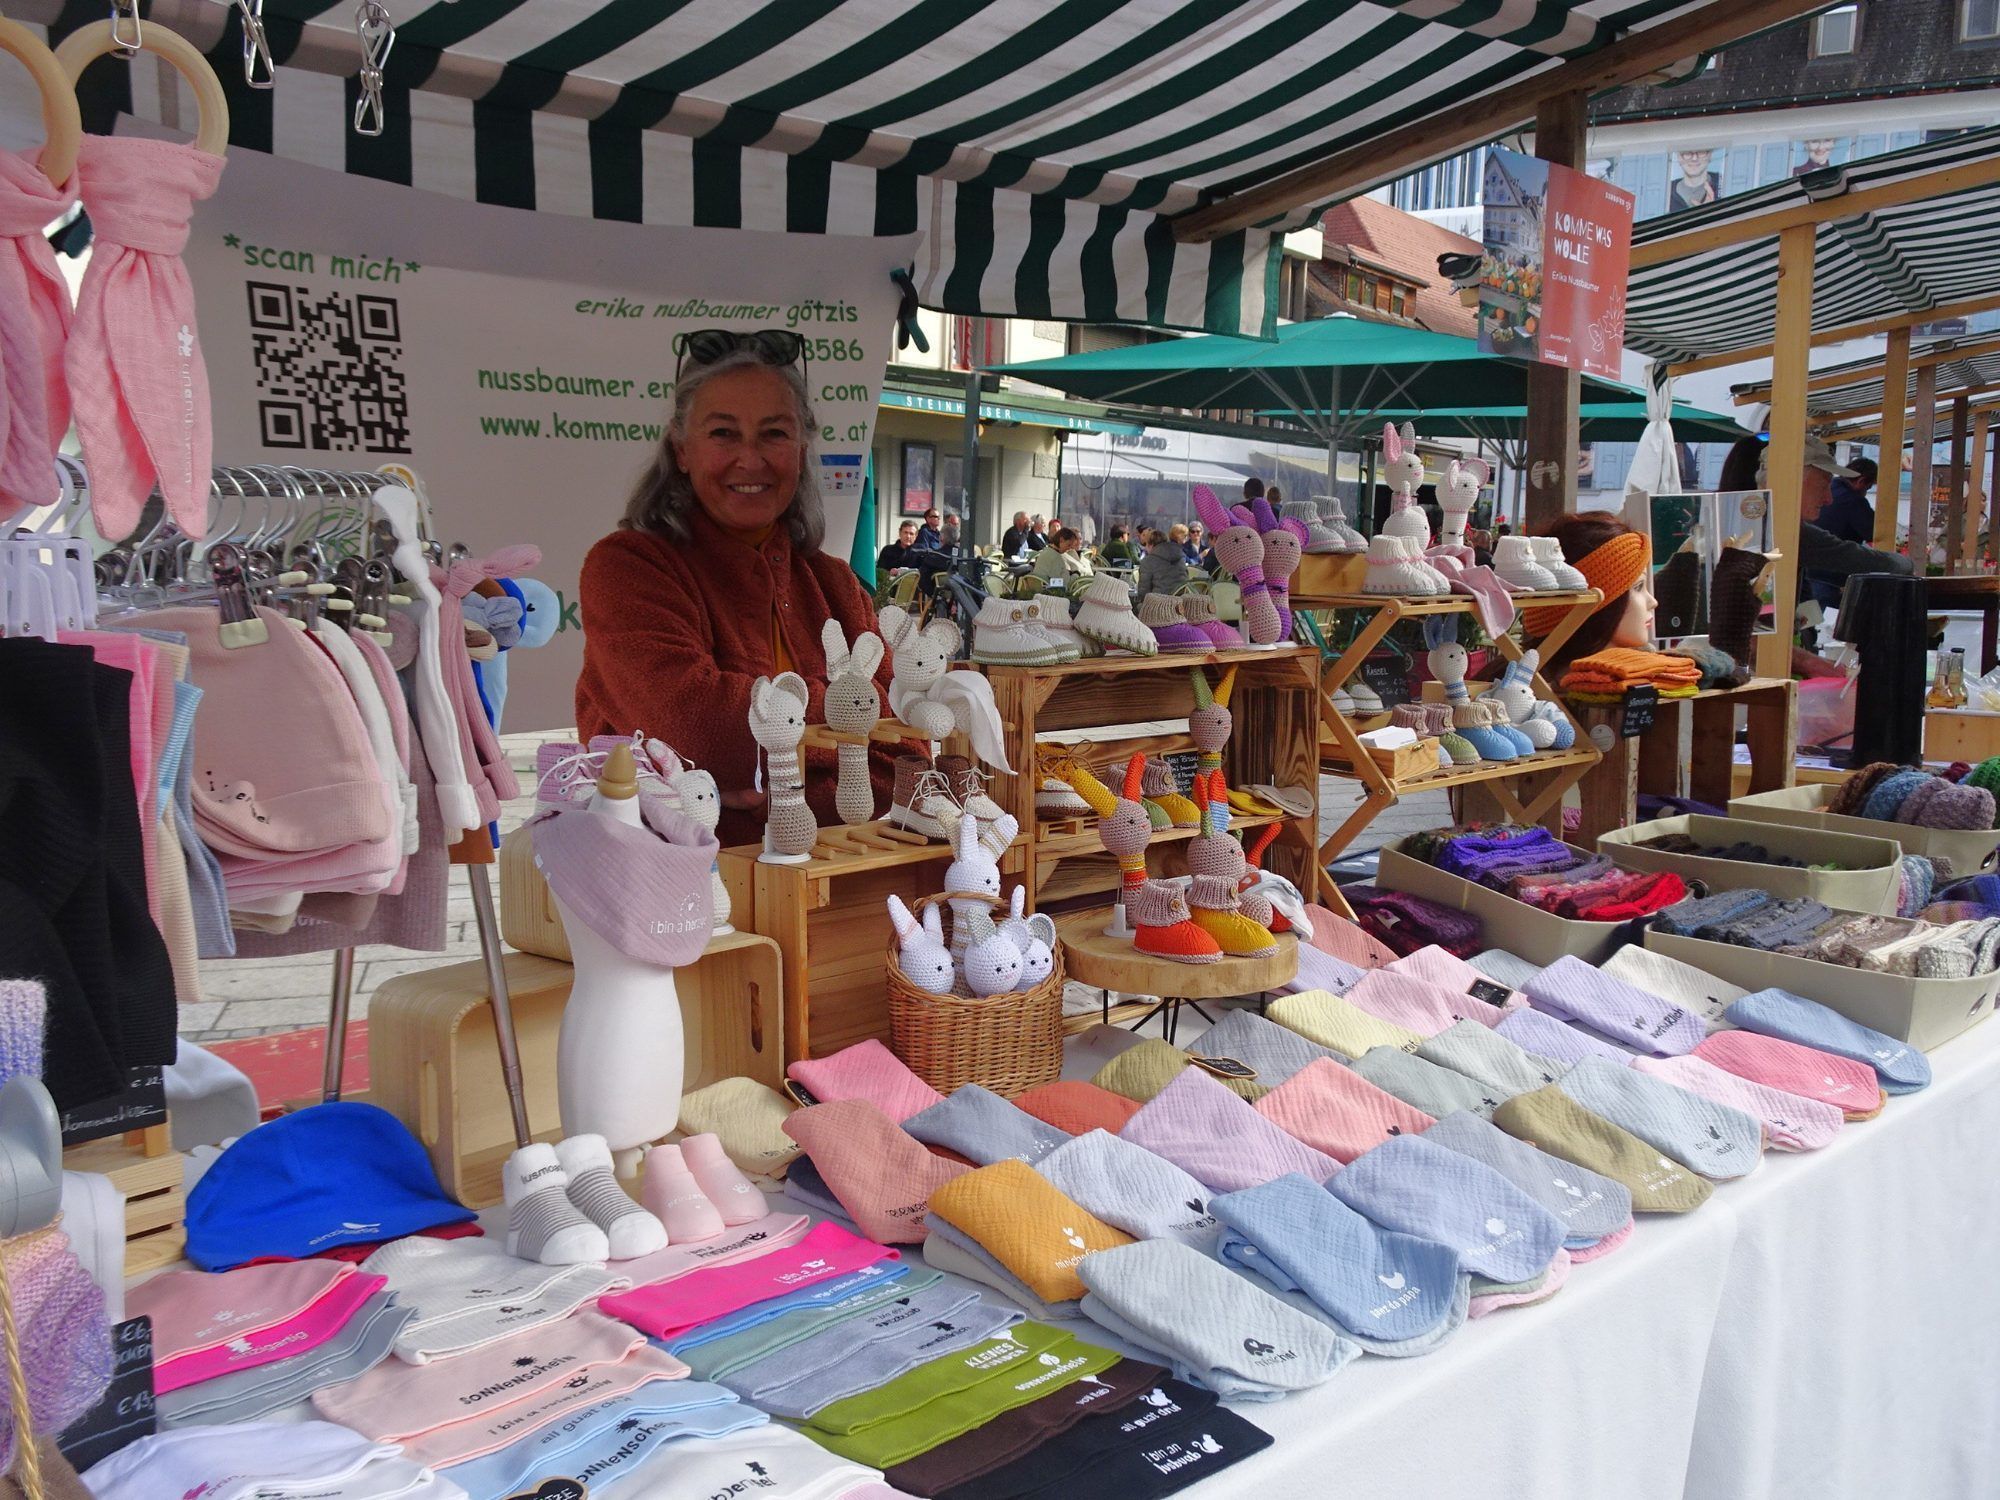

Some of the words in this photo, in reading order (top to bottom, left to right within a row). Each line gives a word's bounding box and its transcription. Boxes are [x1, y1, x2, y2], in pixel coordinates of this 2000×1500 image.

[1555, 211, 1594, 240] KOMME
[1596, 225, 1613, 248] WAS
[1553, 236, 1590, 265] WOLLE
[575, 298, 643, 318] erika
[653, 300, 780, 321] nußbaumer
[786, 300, 859, 328] götzis
[906, 396, 1012, 419] STEINHSER
[1069, 418, 1092, 430] BAR
[657, 920, 674, 934] bin
[1168, 1215, 1217, 1232] minimens
[1399, 1286, 1421, 1306] papa
[964, 1341, 1015, 1369] KLEINES
[562, 1408, 601, 1432] guat
[1121, 1422, 1138, 1433] all
[1134, 1411, 1160, 1429] guat
[1149, 1448, 1169, 1461] bin
[1166, 1443, 1182, 1455] an
